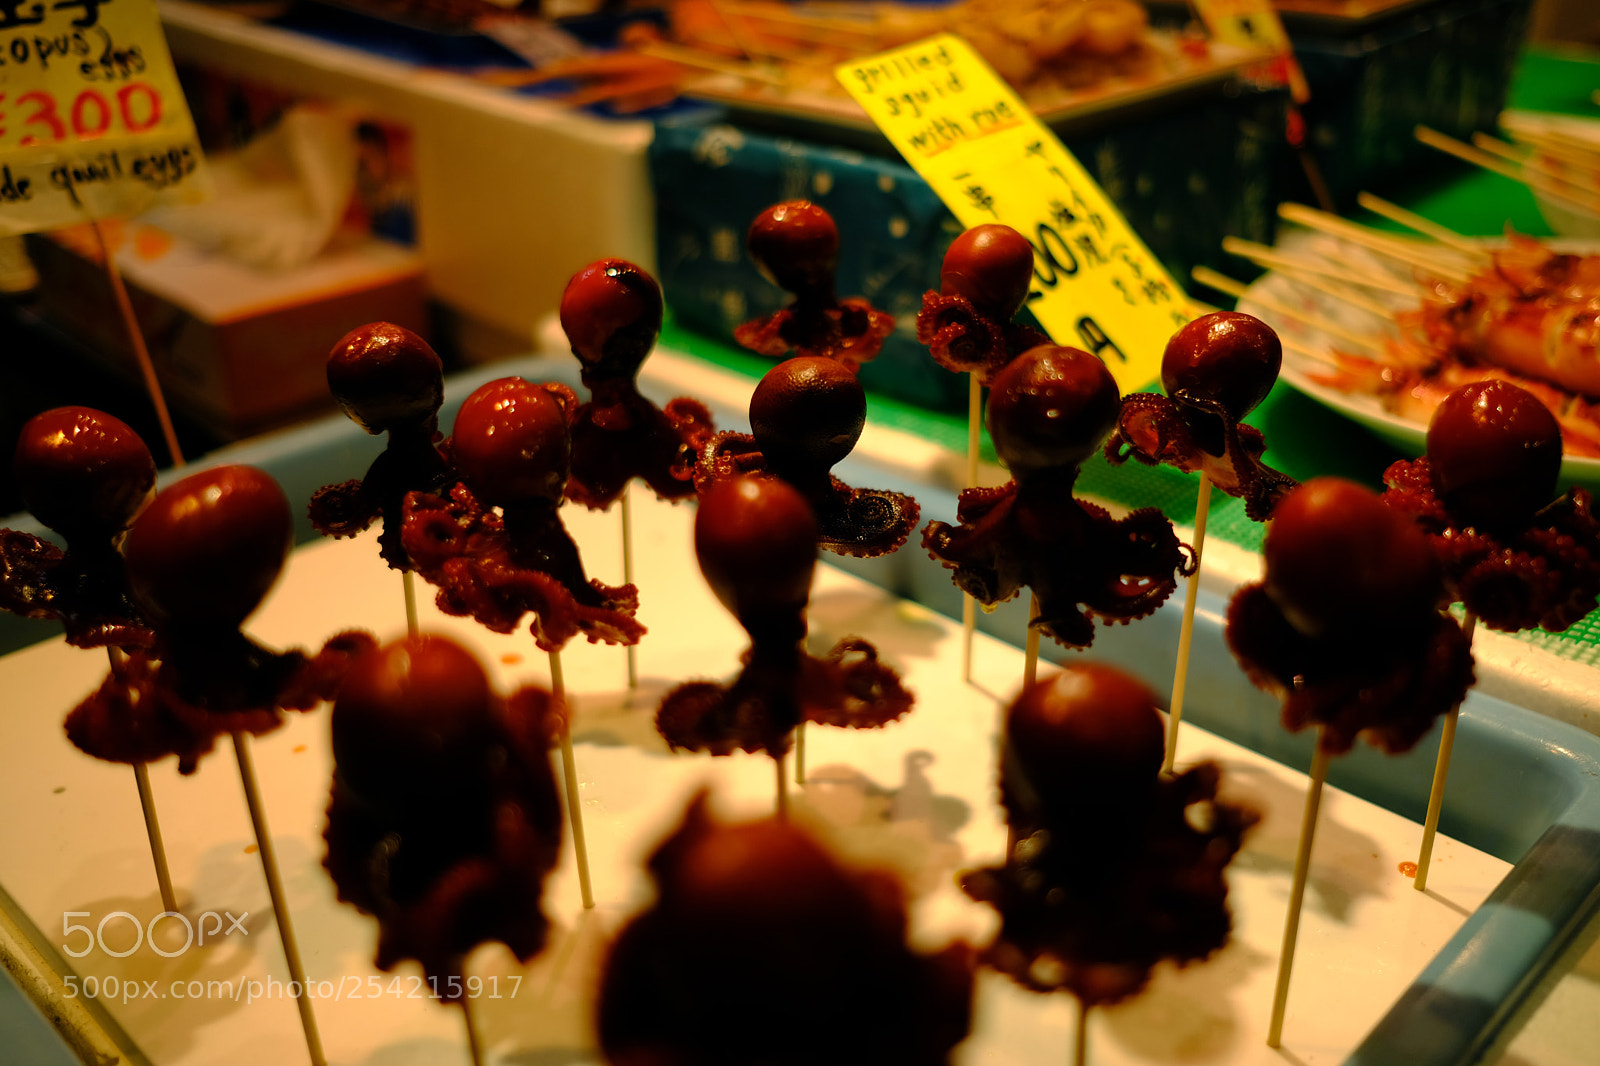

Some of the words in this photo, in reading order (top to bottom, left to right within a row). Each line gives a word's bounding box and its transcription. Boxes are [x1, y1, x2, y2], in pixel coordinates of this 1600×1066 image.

[853, 44, 954, 94] grilled
[0, 82, 162, 145] 300
[885, 71, 965, 118] squid
[908, 116, 966, 150] with
[970, 100, 1014, 128] roe
[50, 148, 122, 208] quail
[132, 146, 197, 190] eggs
